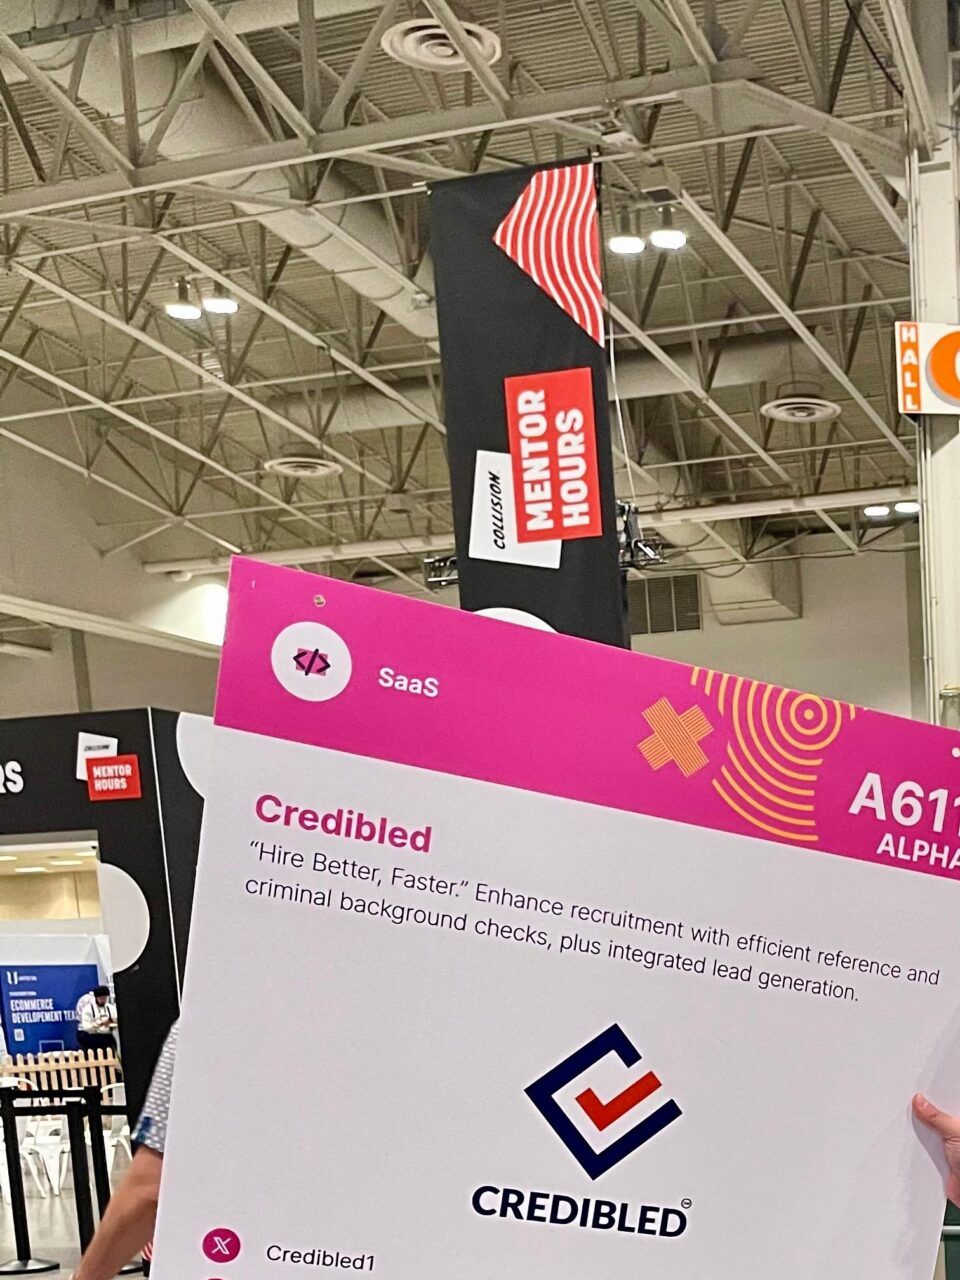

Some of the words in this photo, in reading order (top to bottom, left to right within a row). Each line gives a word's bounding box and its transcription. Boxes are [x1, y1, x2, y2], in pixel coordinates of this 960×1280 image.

[901, 326, 918, 410] HALL
[517, 389, 554, 532] MENTOR
[556, 408, 591, 528] HOURS
[489, 471, 505, 550] COLLISION
[378, 667, 440, 698] SaaS
[92, 764, 132, 778] MENTOR
[94, 778, 128, 791] HOURS
[255, 794, 433, 853] Credibled
[245, 877, 332, 908] criminal
[340, 891, 468, 932] background
[474, 917, 552, 951] checks,
[560, 933, 602, 955] plus
[608, 938, 706, 974] integrated
[712, 959, 752, 983] lead
[757, 970, 859, 1002] generation.
[312, 851, 383, 887] Better,
[475, 883, 564, 916] Enhance
[570, 903, 684, 939] recruitment
[690, 924, 730, 948] with
[736, 933, 811, 963] efficient
[817, 949, 901, 979] reference
[907, 968, 941, 986] and
[10, 999, 54, 1011] ECOMMERCE
[471, 1185, 688, 1238] CREDIBLED
[266, 1245, 375, 1271] Credibled1
